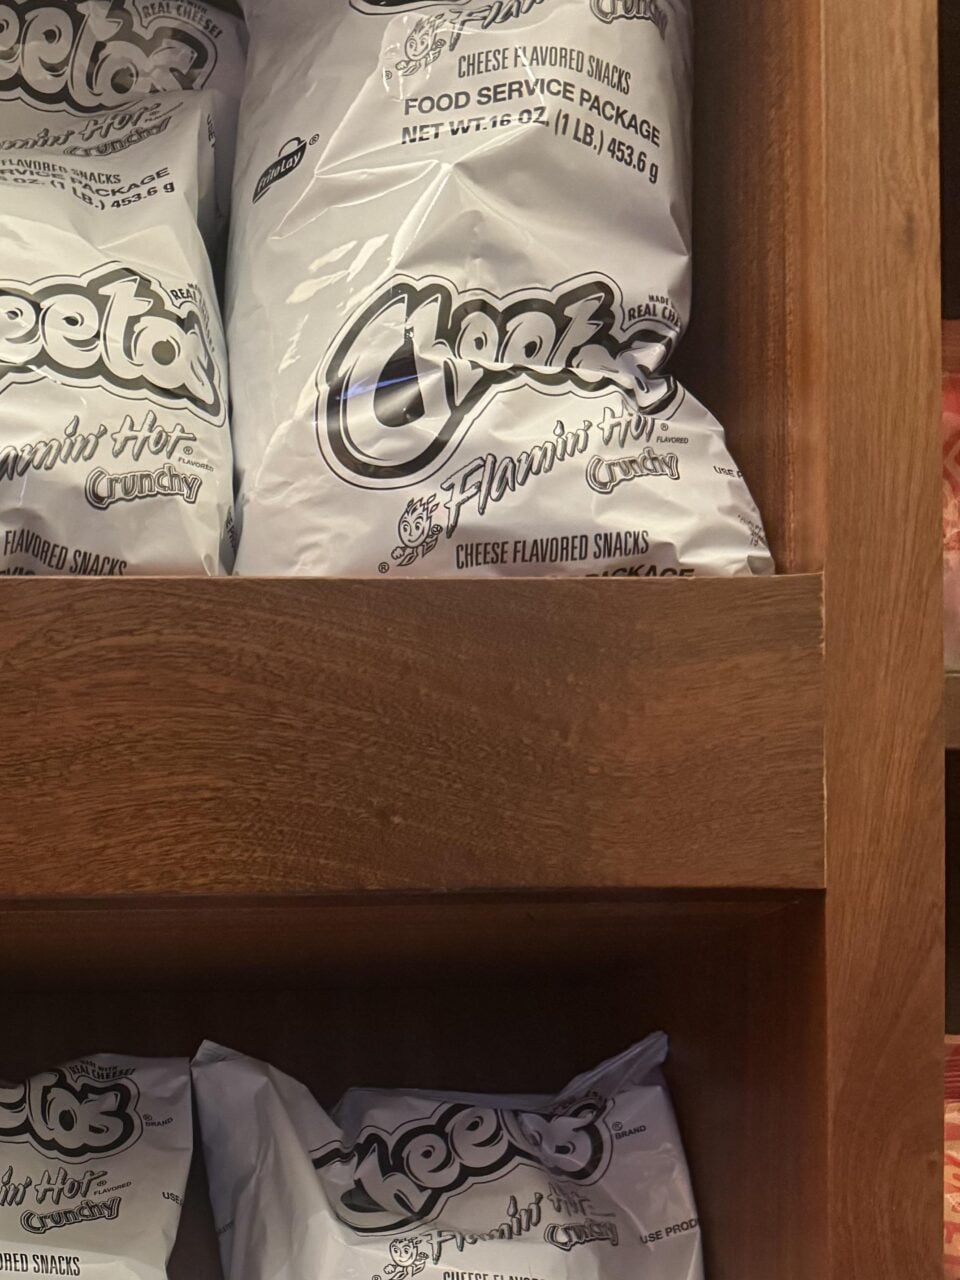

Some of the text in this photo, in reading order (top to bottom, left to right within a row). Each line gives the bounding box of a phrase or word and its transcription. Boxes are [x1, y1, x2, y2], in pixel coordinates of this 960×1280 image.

[457, 45, 632, 95] CHEESE FLAVORED SNACKS
[403, 78, 661, 148] FOOD SERVICE PACKAGE
[628, 303, 658, 321] REAL
[111, 410, 197, 462] Hot
[655, 435, 689, 445] FLAVORED
[177, 456, 215, 473] FLAVORED
[585, 447, 680, 494] Crunchy
[85, 463, 203, 510] Crunchy
[4, 528, 71, 571] FLAVORED
[72, 548, 129, 576] SNACKS
[455, 539, 509, 570] CHEESE
[512, 534, 589, 564] FLAVORED
[593, 530, 650, 560] SNACKS
[145, 1117, 174, 1127] BRAND
[615, 1124, 648, 1141] BRAND
[34, 1166, 108, 1205] Hot
[93, 1181, 132, 1196] FLAVORED
[20, 1196, 122, 1235] Crunchy
[32, 1254, 81, 1277] SNACKS
